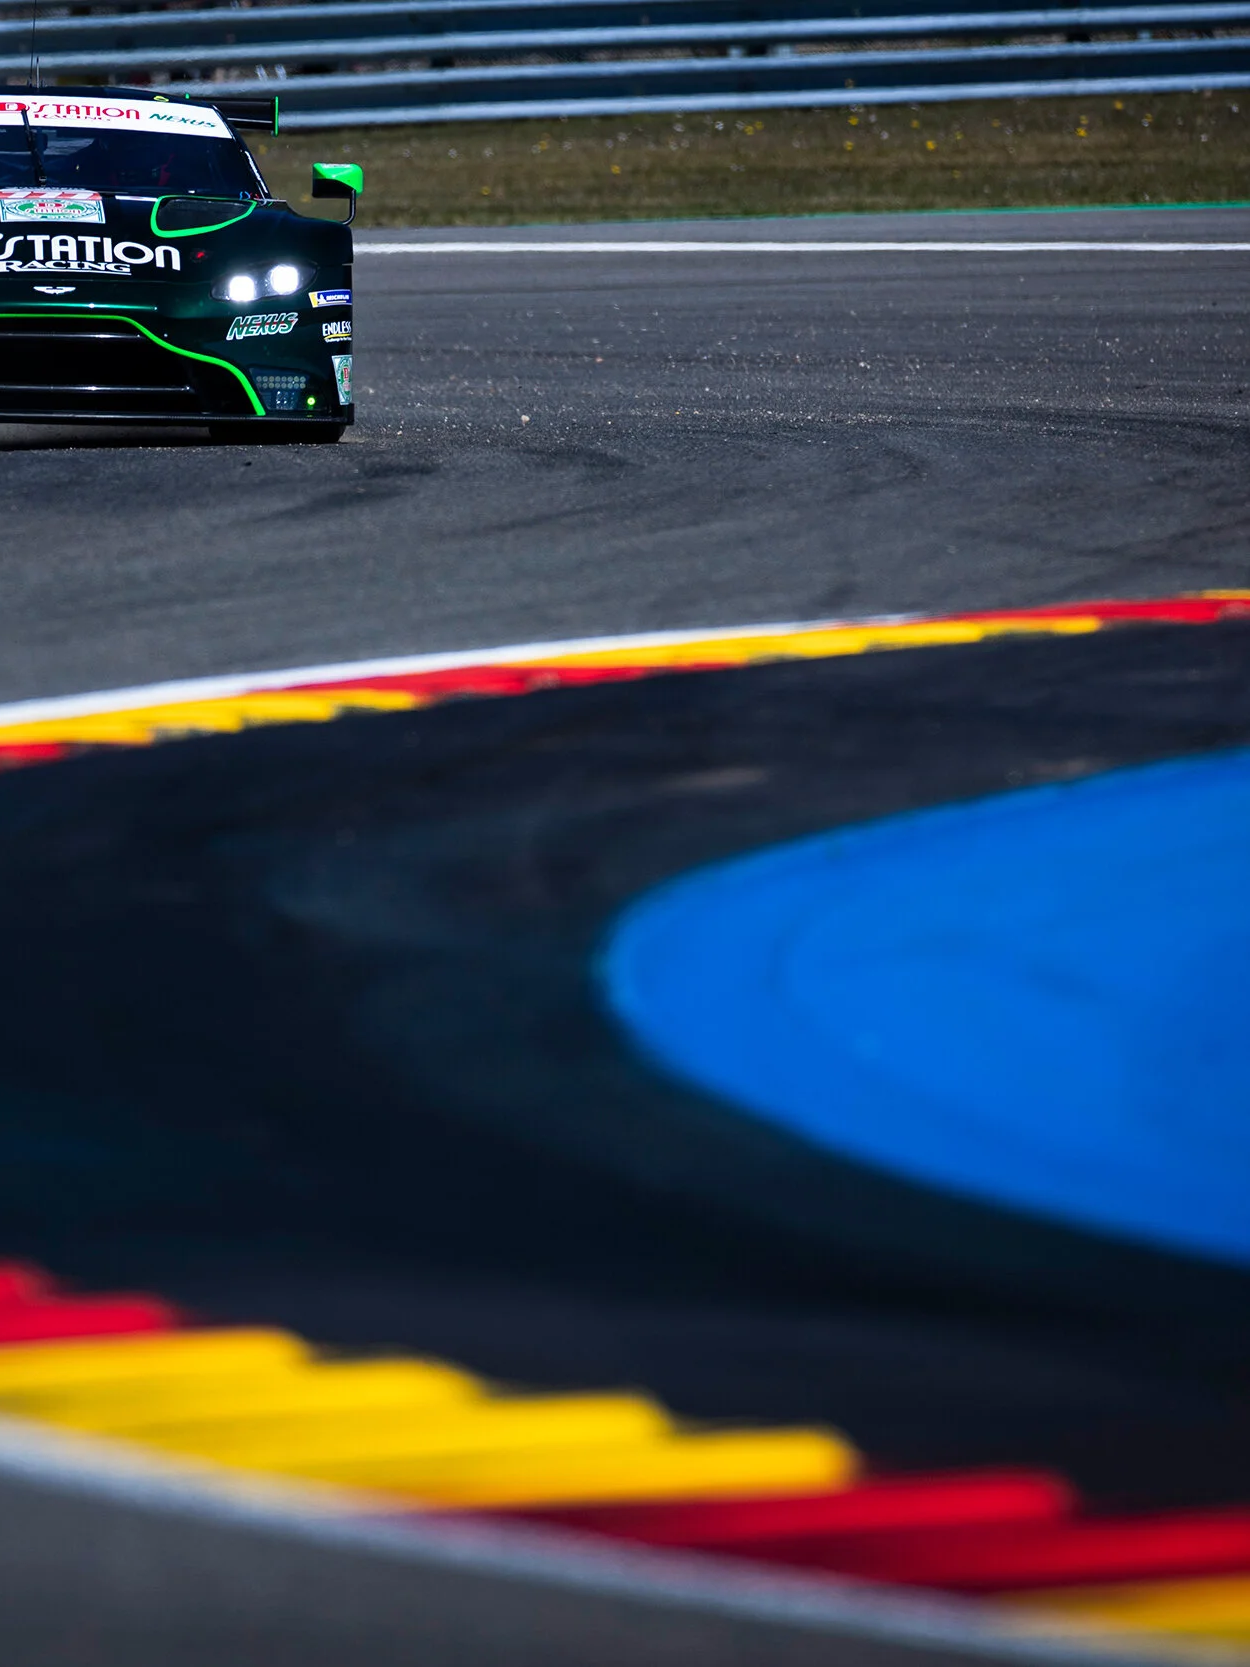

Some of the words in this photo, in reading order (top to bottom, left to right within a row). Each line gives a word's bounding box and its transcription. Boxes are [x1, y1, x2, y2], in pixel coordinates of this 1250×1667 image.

[148, 113, 217, 128] NEXUS
[225, 311, 299, 341] NEXUS
[322, 320, 352, 337] ENDLESS
